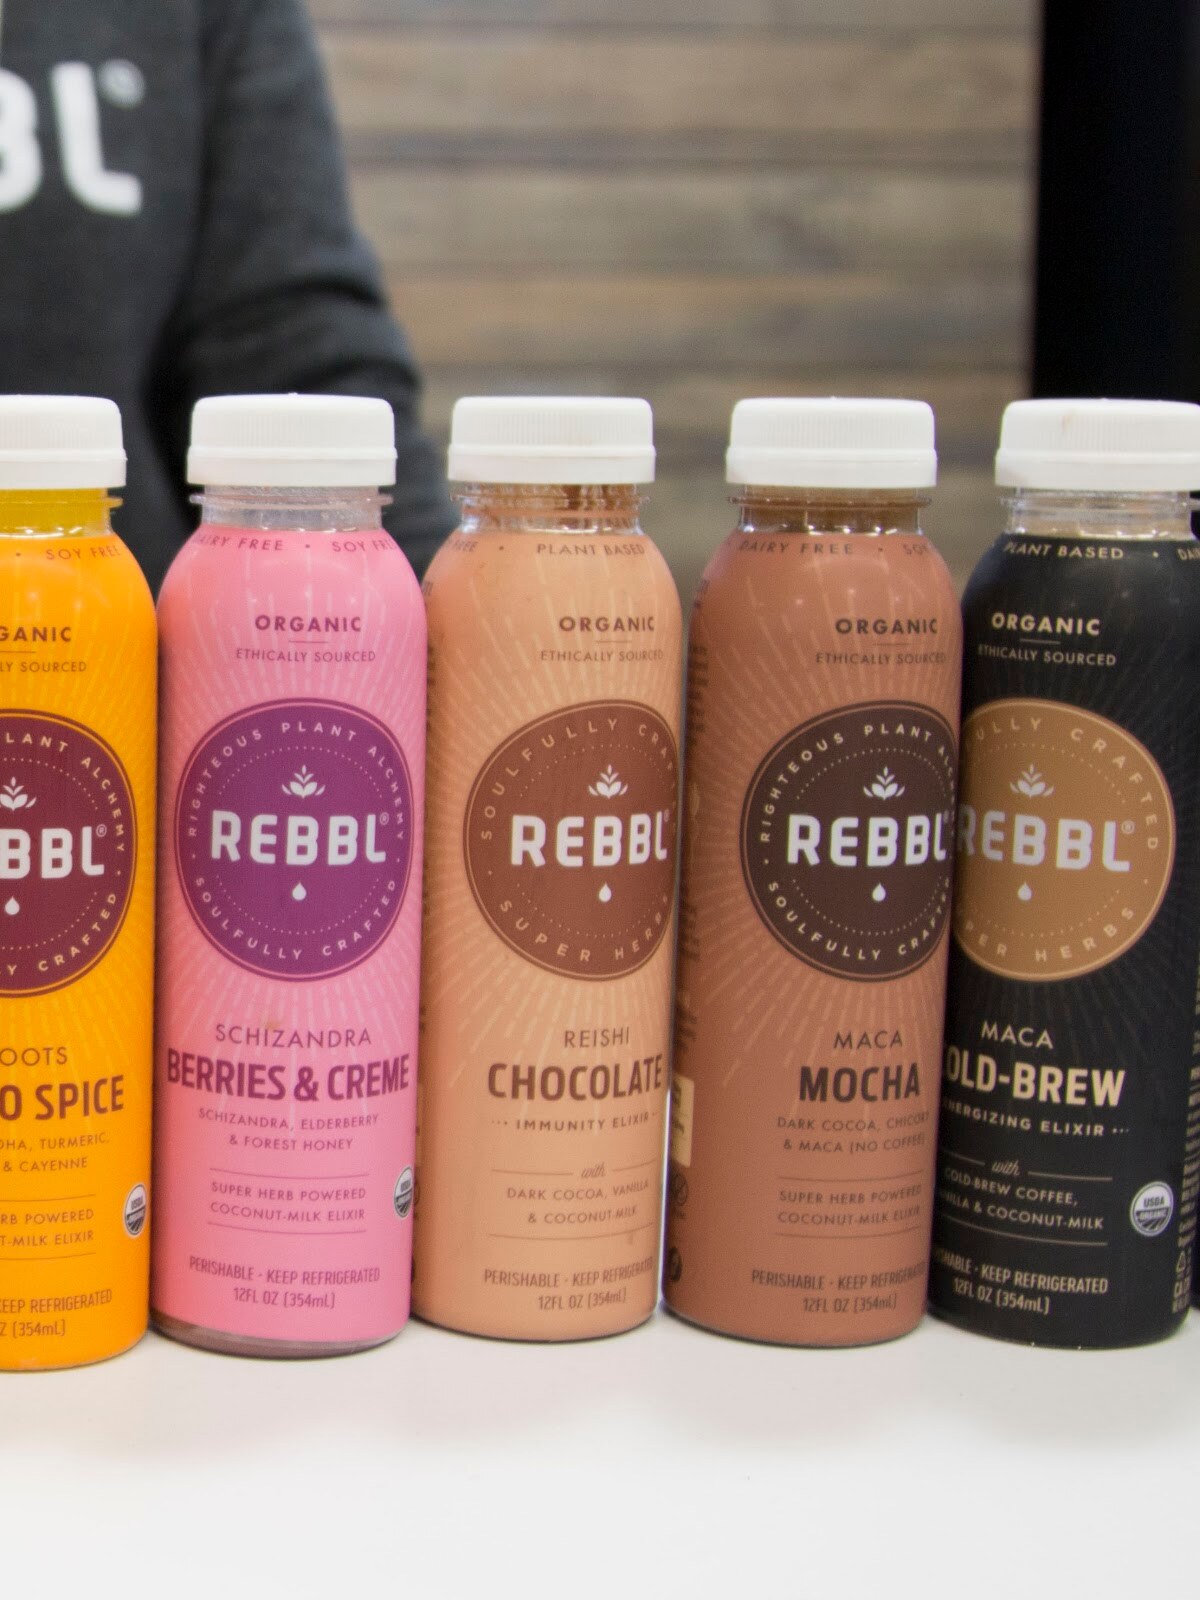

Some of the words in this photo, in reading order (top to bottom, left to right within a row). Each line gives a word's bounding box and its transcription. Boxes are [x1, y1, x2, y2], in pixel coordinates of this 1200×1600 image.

[537, 543, 597, 555] PLANT
[604, 544, 644, 555] BASED
[801, 543, 853, 555] FREE
[1004, 541, 1051, 556] PLANT
[1058, 545, 1124, 559] BASED
[256, 615, 361, 632] ORGANIC
[559, 616, 654, 632] ORGANIC
[836, 618, 937, 634] ORGANIC
[991, 612, 1100, 636] ORGANIC
[21, 661, 86, 672] SOURCED
[978, 644, 1038, 661] ETHICALLY
[1044, 651, 1116, 666] SOURCED
[188, 729, 261, 837] RIGHTEOUS
[282, 722, 356, 742] PLANT
[481, 718, 617, 840] SOULFULLY
[761, 733, 844, 842] RIGHTEOUS
[864, 724, 932, 742] PLANT
[1071, 728, 1158, 850] CRAFTED
[81, 757, 125, 853] ALCHEMY
[211, 809, 386, 866] REBBL
[511, 811, 667, 867] REBBL
[787, 812, 946, 867] REBBL
[196, 877, 301, 960] SOULFULLY
[323, 880, 395, 956] CRAFTED
[500, 900, 590, 961] SUPER
[768, 881, 880, 960] SOULFULLY
[38, 893, 116, 971] CRAFTED
[1035, 907, 1134, 962] HERBS
[216, 1024, 371, 1049] SCHIZANDRA
[565, 1027, 629, 1048] REISHI
[834, 1030, 903, 1049] MACA
[981, 1020, 1054, 1049] MACA
[168, 1048, 286, 1100] BERRIES
[293, 1066, 319, 1101] &
[328, 1054, 410, 1100] CREME
[488, 1054, 663, 1101] CHOCOLATE
[800, 1063, 920, 1102] MOCHA
[946, 1046, 1125, 1107] OLD-BREW
[35, 1074, 124, 1120] SPICE
[199, 1108, 294, 1131] SCHIZANDRA,
[301, 1114, 378, 1130] ELDERBERRY
[516, 1119, 604, 1131] IMMUNITY
[613, 1112, 648, 1128] ELIXIR
[777, 1116, 815, 1129] DARK
[1040, 1120, 1104, 1136] ELIXIR
[230, 1135, 238, 1145] &
[244, 1136, 296, 1150] FOREST
[304, 1138, 353, 1150] HONEY
[3, 1161, 12, 1171] &
[20, 1157, 88, 1172] CAYENNE
[581, 1163, 606, 1180] with
[992, 1160, 1020, 1176] with
[507, 1187, 545, 1200] DARK
[554, 1189, 607, 1201] COCOA,
[1016, 1187, 1078, 1206] COFFEE,
[25, 1208, 94, 1224] POWERED
[528, 1213, 536, 1223] &
[974, 1203, 982, 1213] &
[988, 1205, 1104, 1230] COCONUT-MILK
[54, 1230, 93, 1245] ELIXIR
[190, 1256, 254, 1281] PERISHABLE
[267, 1270, 298, 1284] KEEP
[302, 1268, 380, 1286] REFRIGERATED
[981, 1264, 1011, 1283] KEEP
[1015, 1271, 1108, 1293] REFRIGERATED
